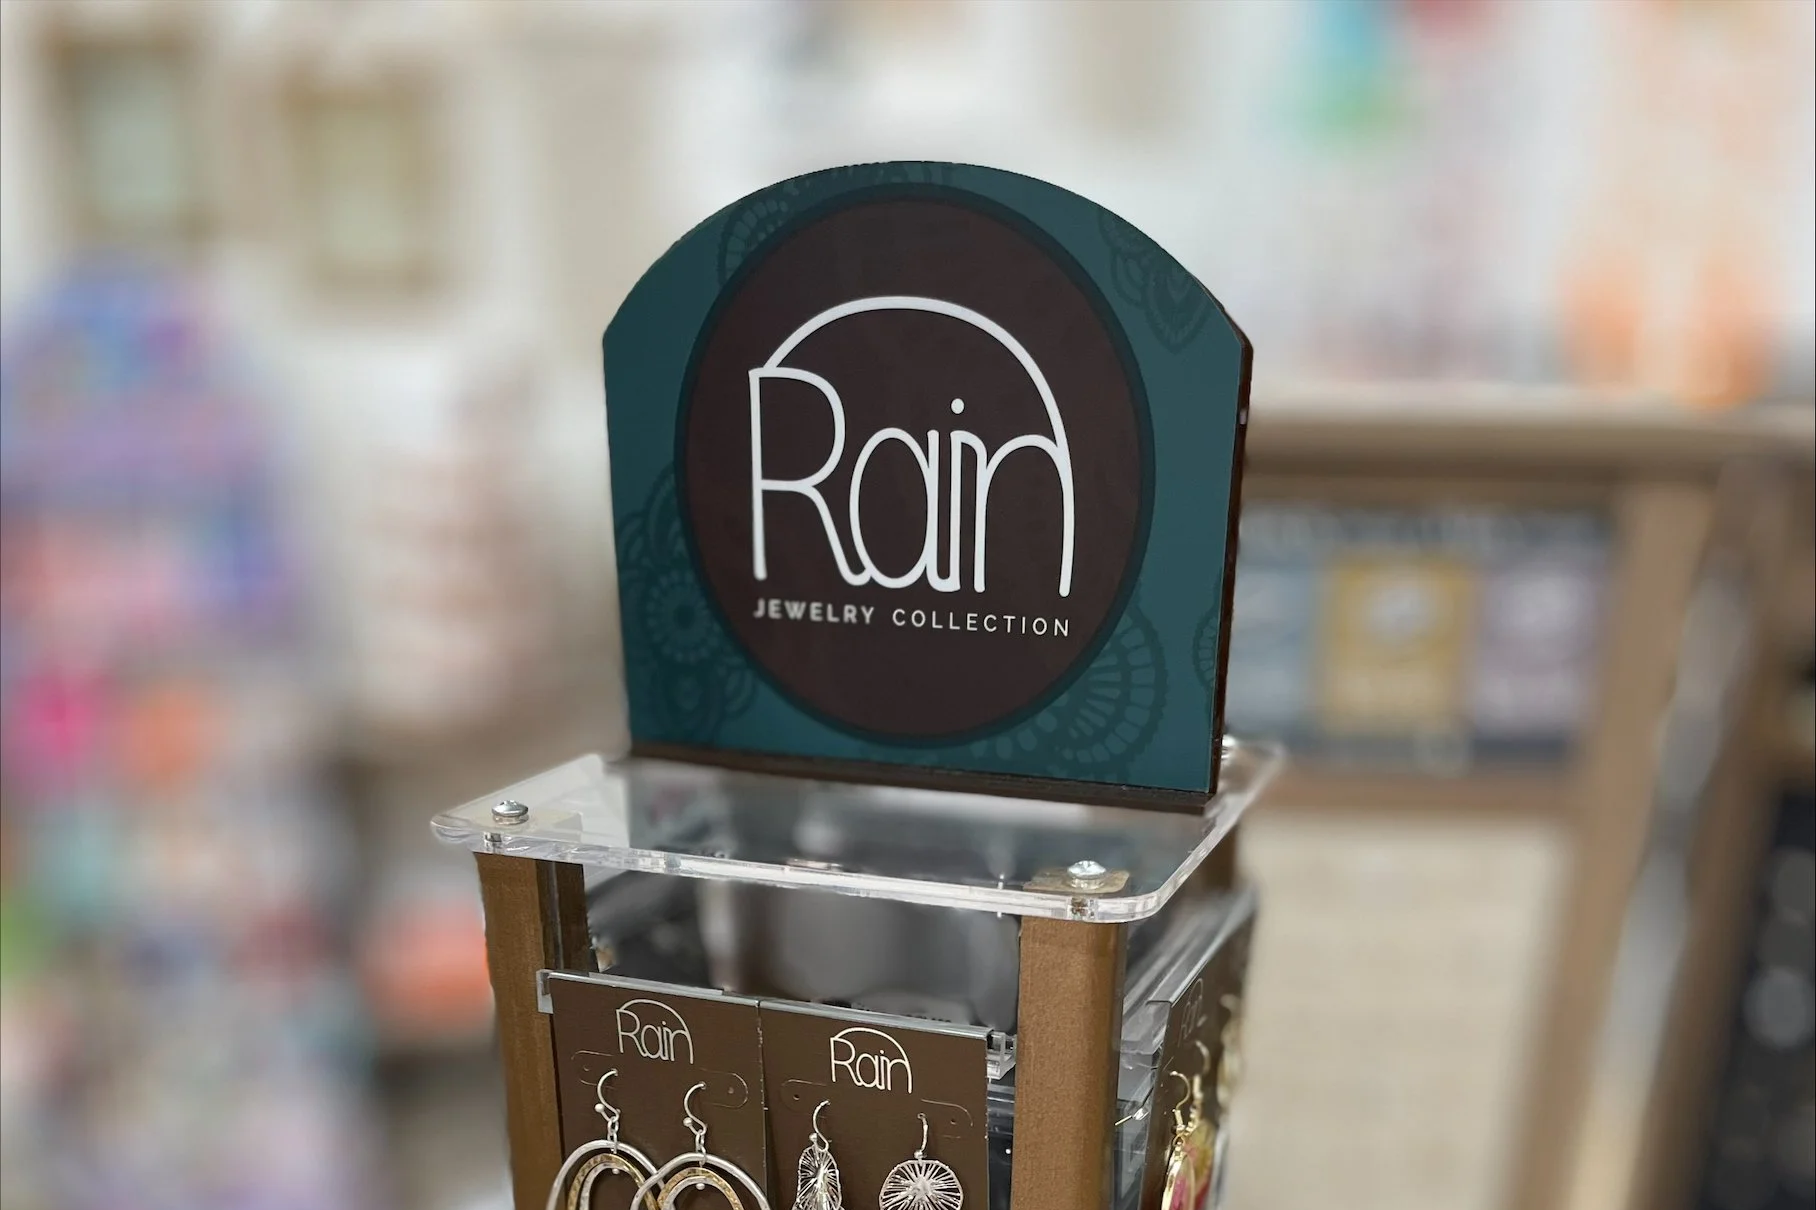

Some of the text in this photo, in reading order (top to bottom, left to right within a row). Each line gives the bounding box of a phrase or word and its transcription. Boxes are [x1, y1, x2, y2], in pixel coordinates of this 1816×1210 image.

[748, 296, 1075, 598] Rain
[753, 598, 1069, 638] JEWELRY COLLECTION
[616, 999, 693, 1064] Rain
[830, 1027, 912, 1094] Rain
